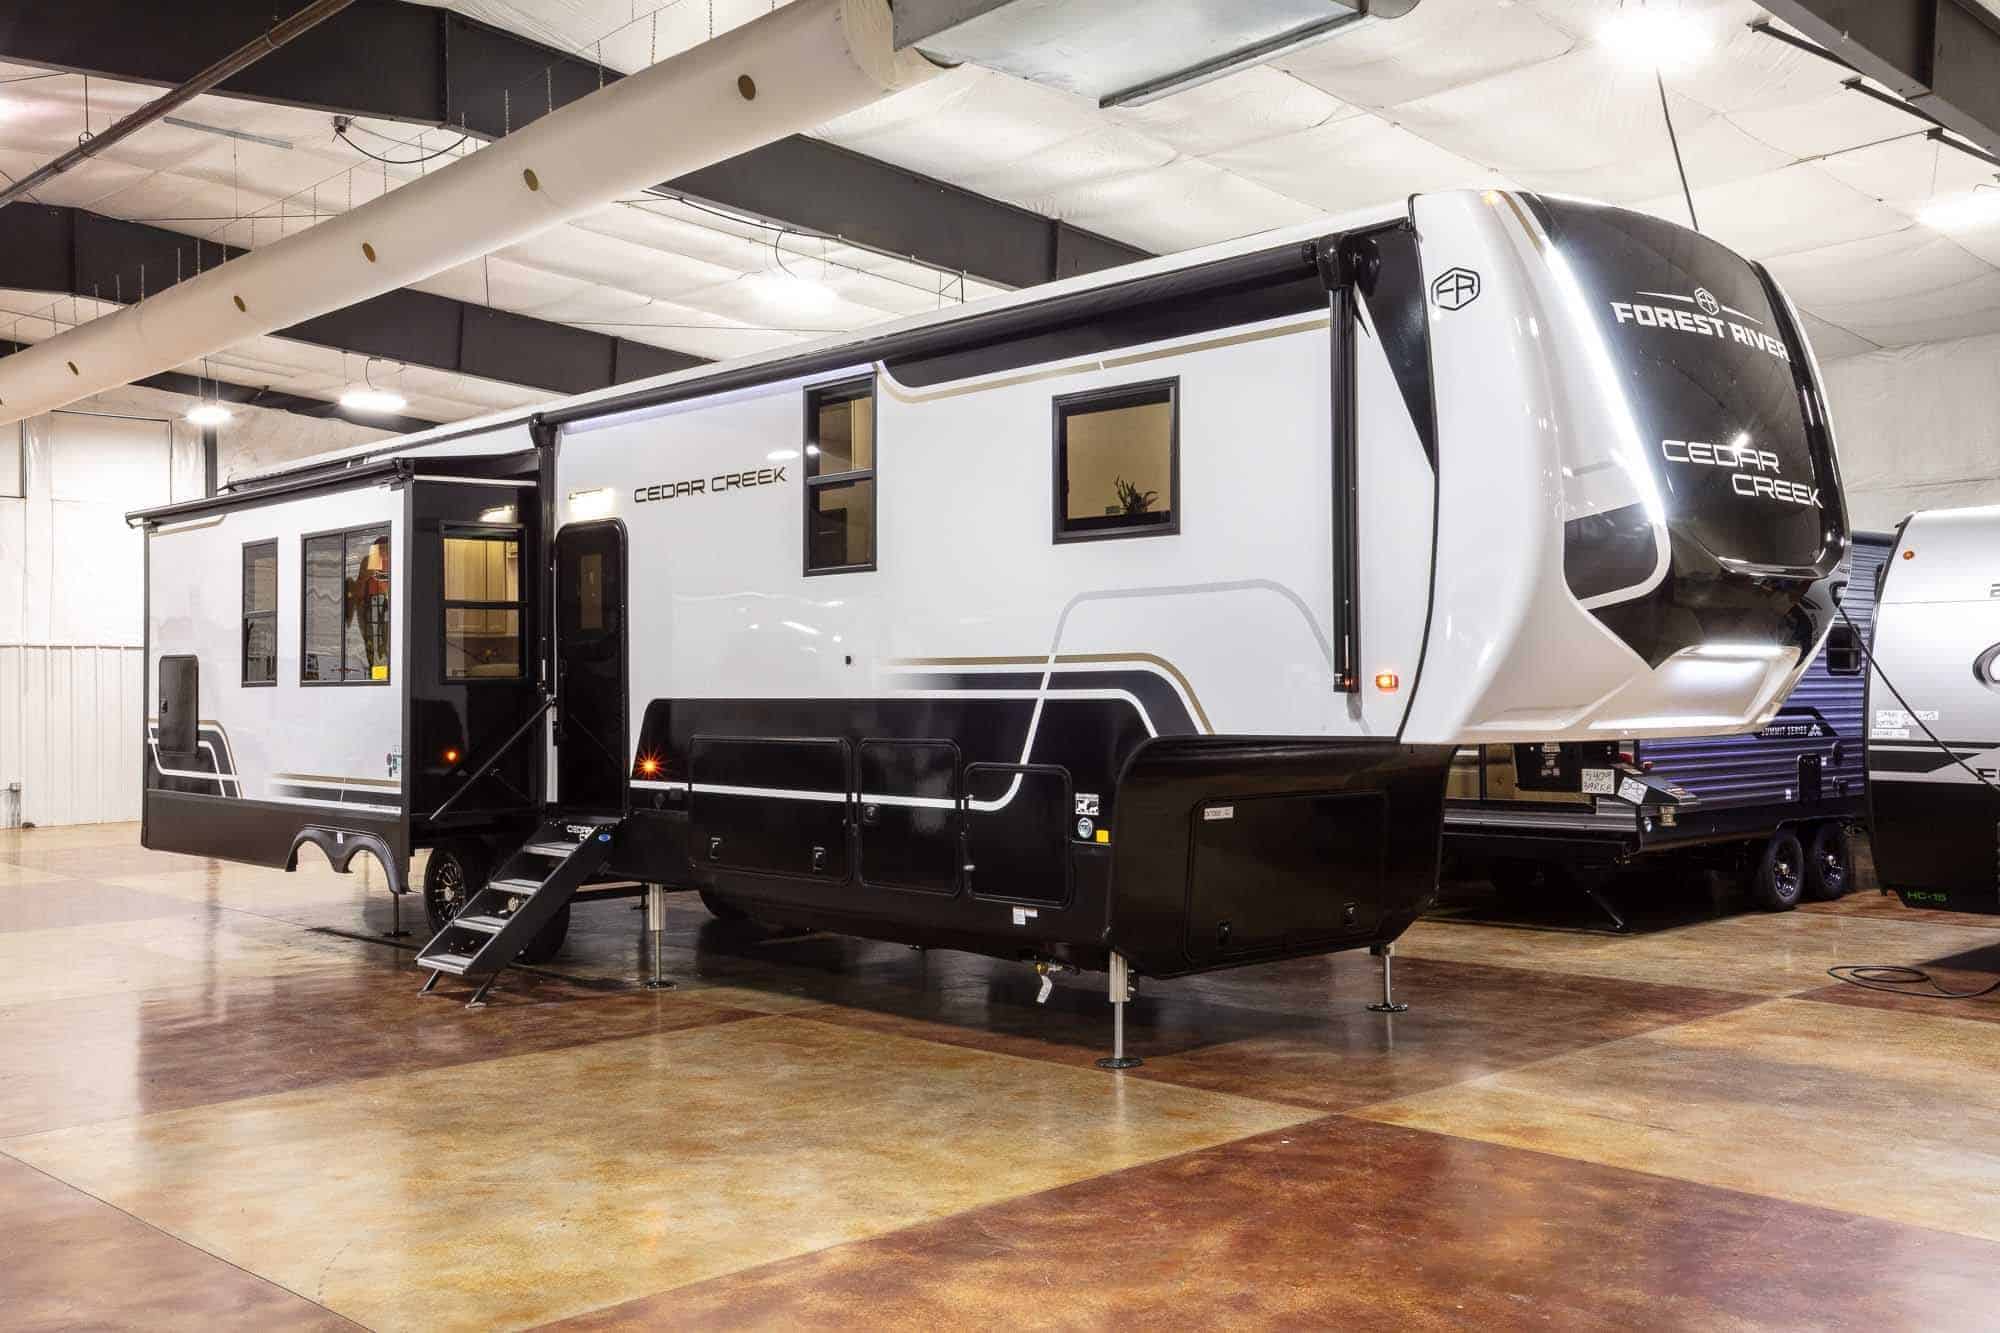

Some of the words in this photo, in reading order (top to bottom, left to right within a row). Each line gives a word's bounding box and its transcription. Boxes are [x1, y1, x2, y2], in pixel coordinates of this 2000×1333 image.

[1610, 302, 1727, 339] FOREST
[1728, 322, 1790, 362] RIVER
[1662, 440, 1781, 474] CEDAR
[634, 479, 705, 503] CEDAR
[711, 466, 787, 492] CREEK
[1732, 474, 1824, 509] CREEK
